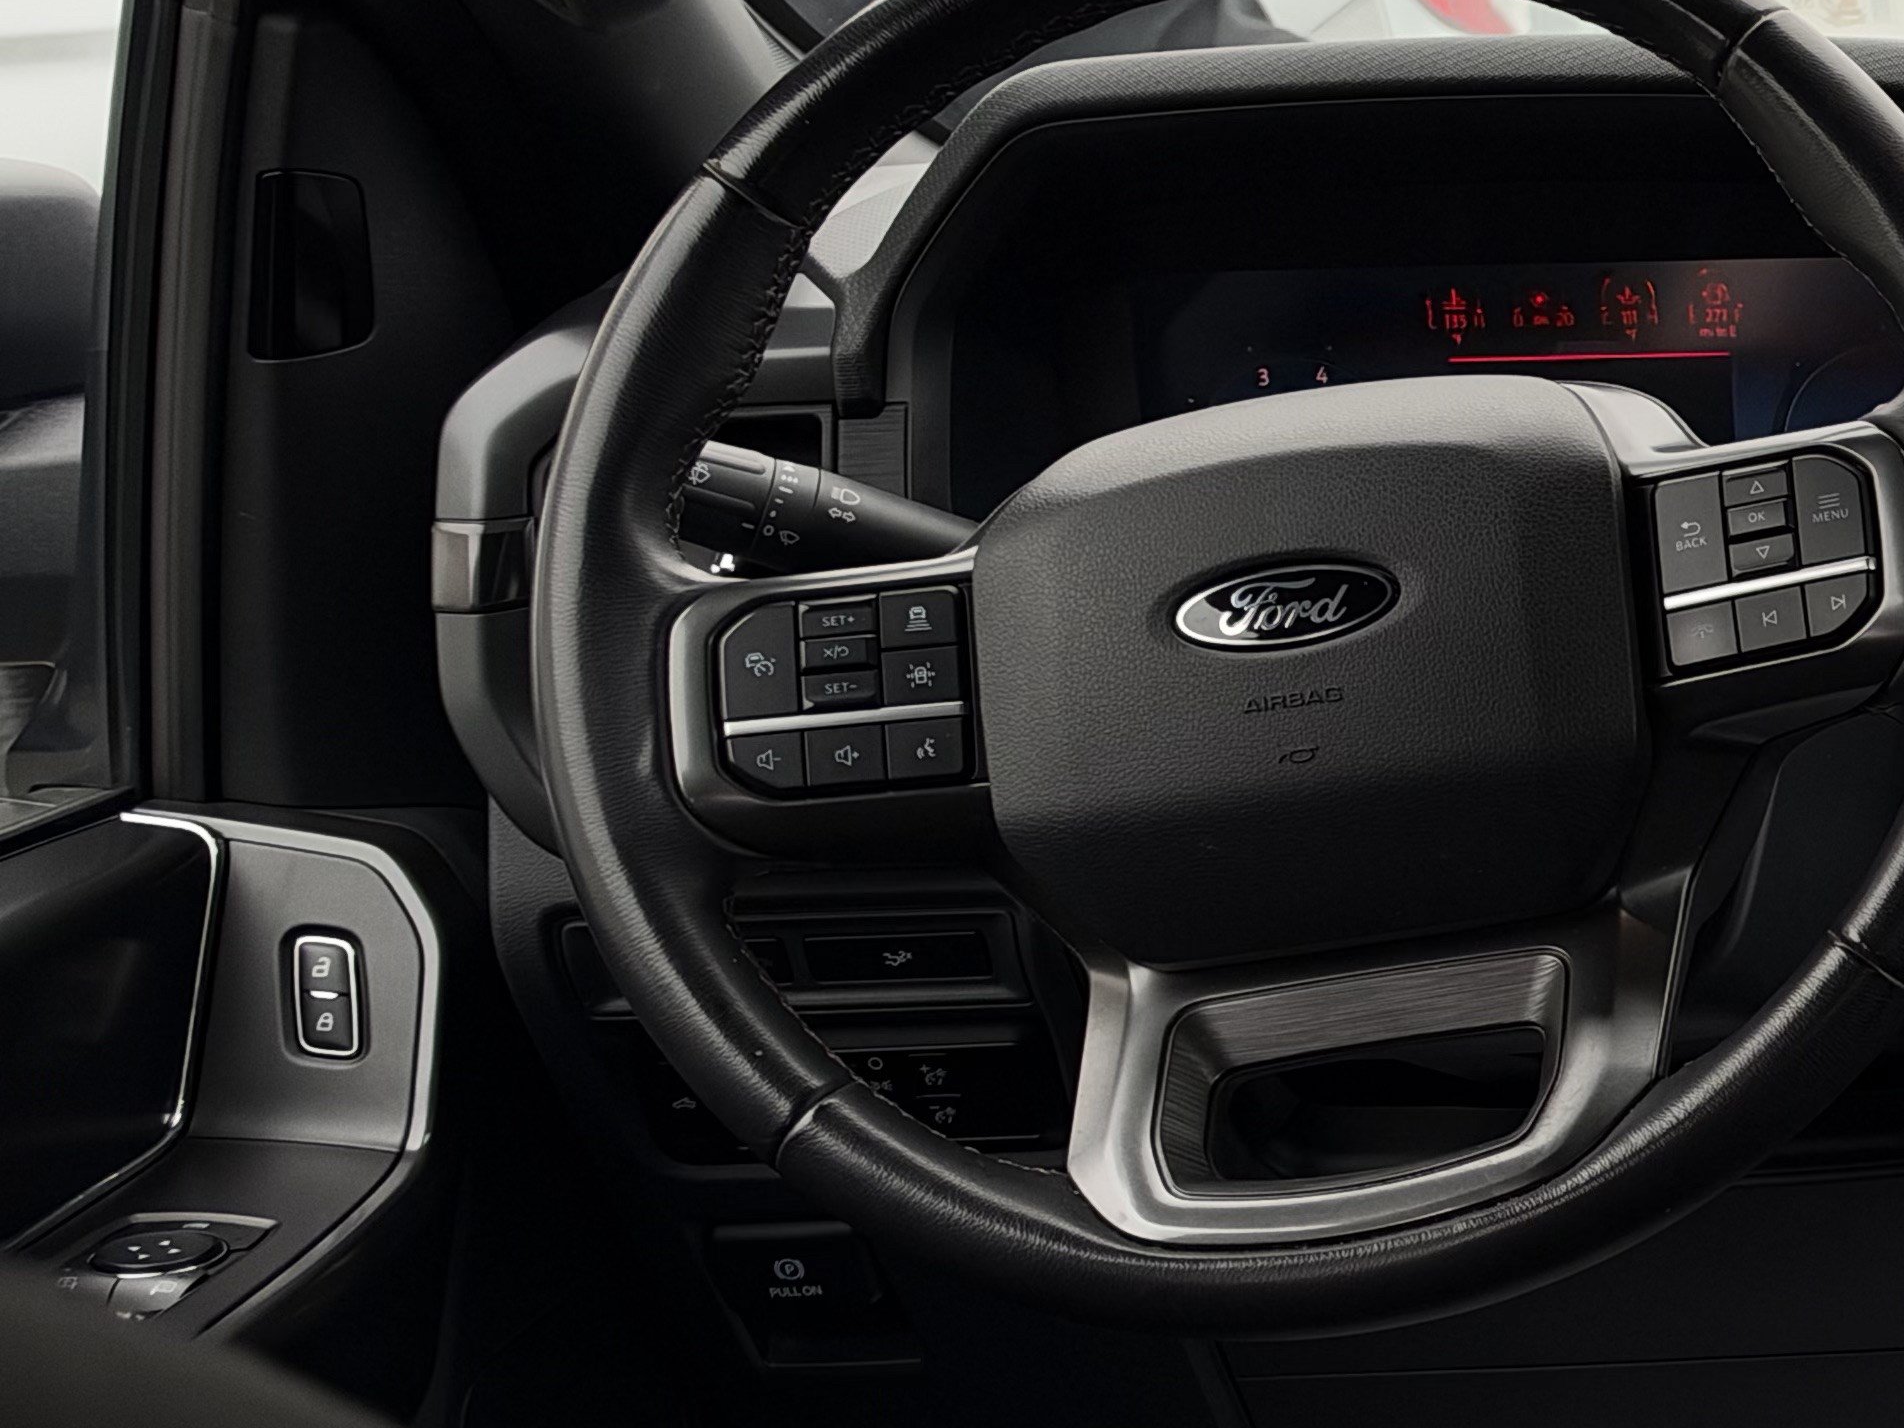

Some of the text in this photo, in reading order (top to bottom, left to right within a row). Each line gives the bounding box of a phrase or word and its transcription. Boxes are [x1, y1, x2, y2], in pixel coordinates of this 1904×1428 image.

[1258, 368, 1270, 386] 3
[1315, 366, 1328, 385] 4
[1748, 510, 1766, 523] OK
[1812, 509, 1849, 523] MENU
[1675, 535, 1707, 552] BACK
[1219, 577, 1350, 637] Ford
[1243, 686, 1344, 714] AIRBAG
[770, 1285, 823, 1300] PULL ON
